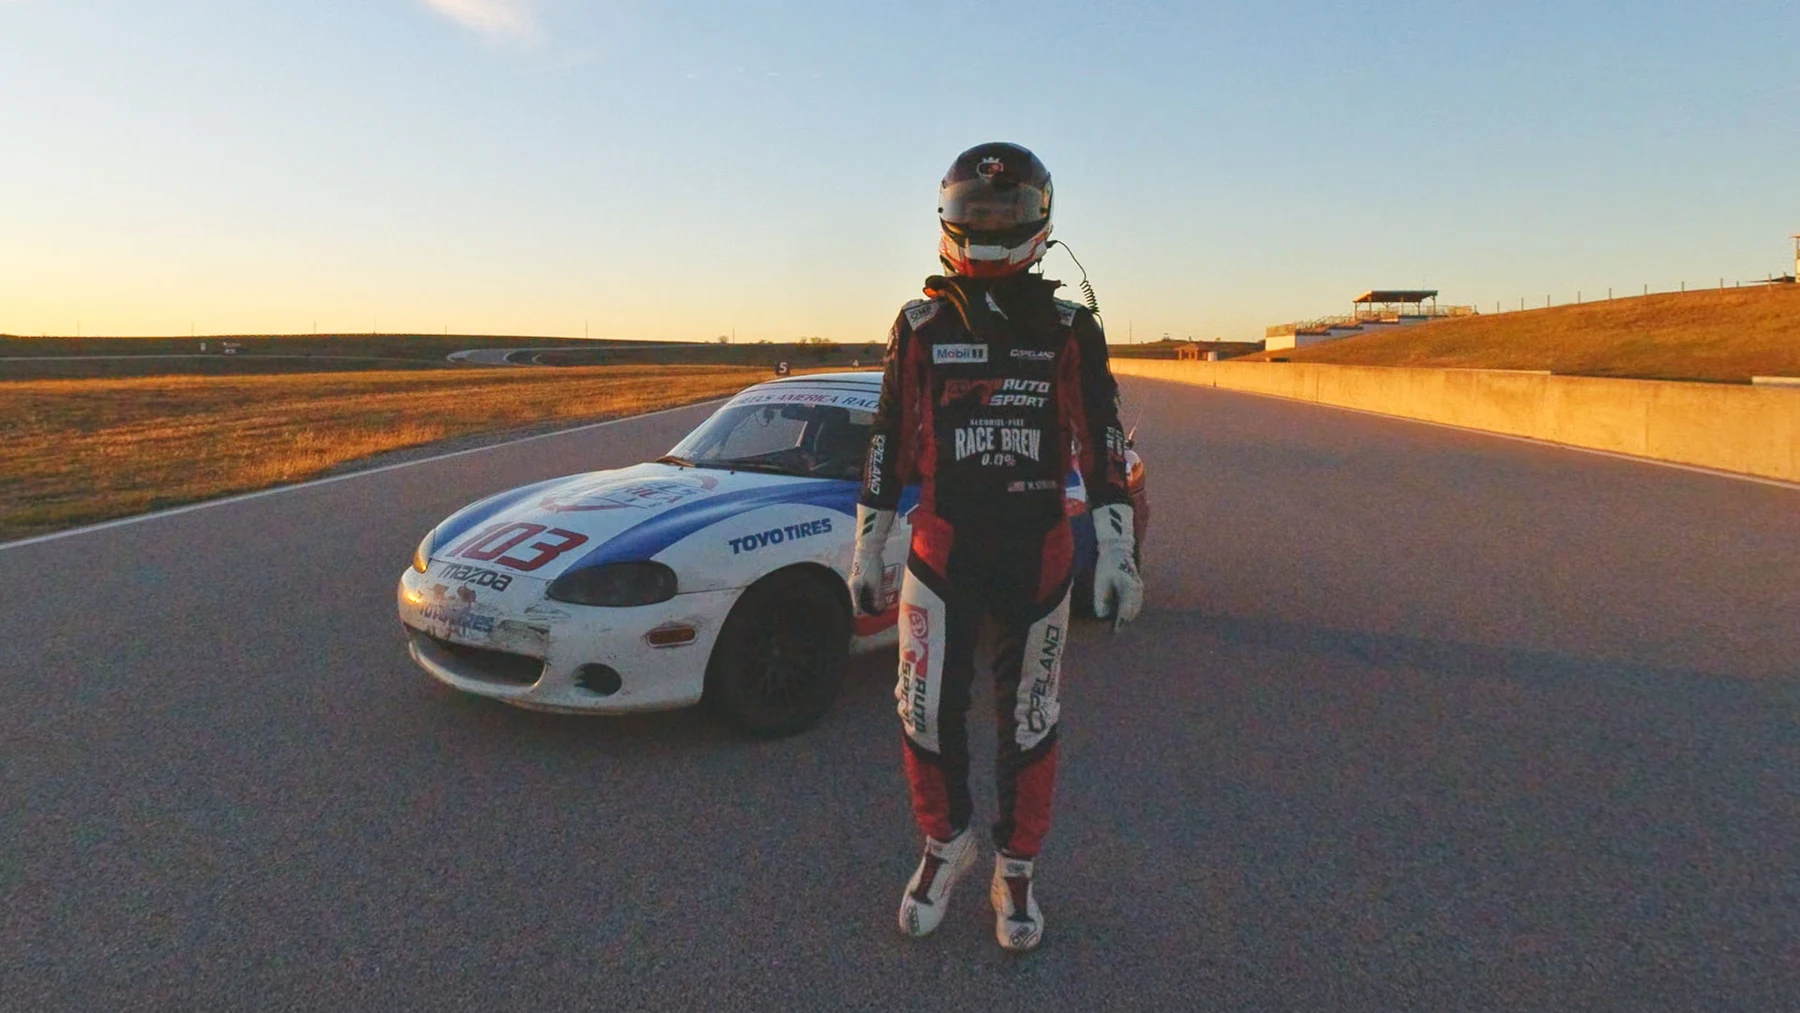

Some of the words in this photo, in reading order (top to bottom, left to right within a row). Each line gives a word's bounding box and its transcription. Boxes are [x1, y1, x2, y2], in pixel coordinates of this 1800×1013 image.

[936, 348, 970, 359] Mobil
[779, 361, 788, 373] 5
[1003, 378, 1050, 393] AUTO
[776, 393, 839, 404] AMERICA
[989, 394, 1047, 407] SPORT
[955, 427, 996, 461] RACE
[1001, 428, 1041, 461] BREW
[729, 528, 784, 555] TOYO
[784, 518, 832, 540] TIRES
[447, 521, 589, 572] 103
